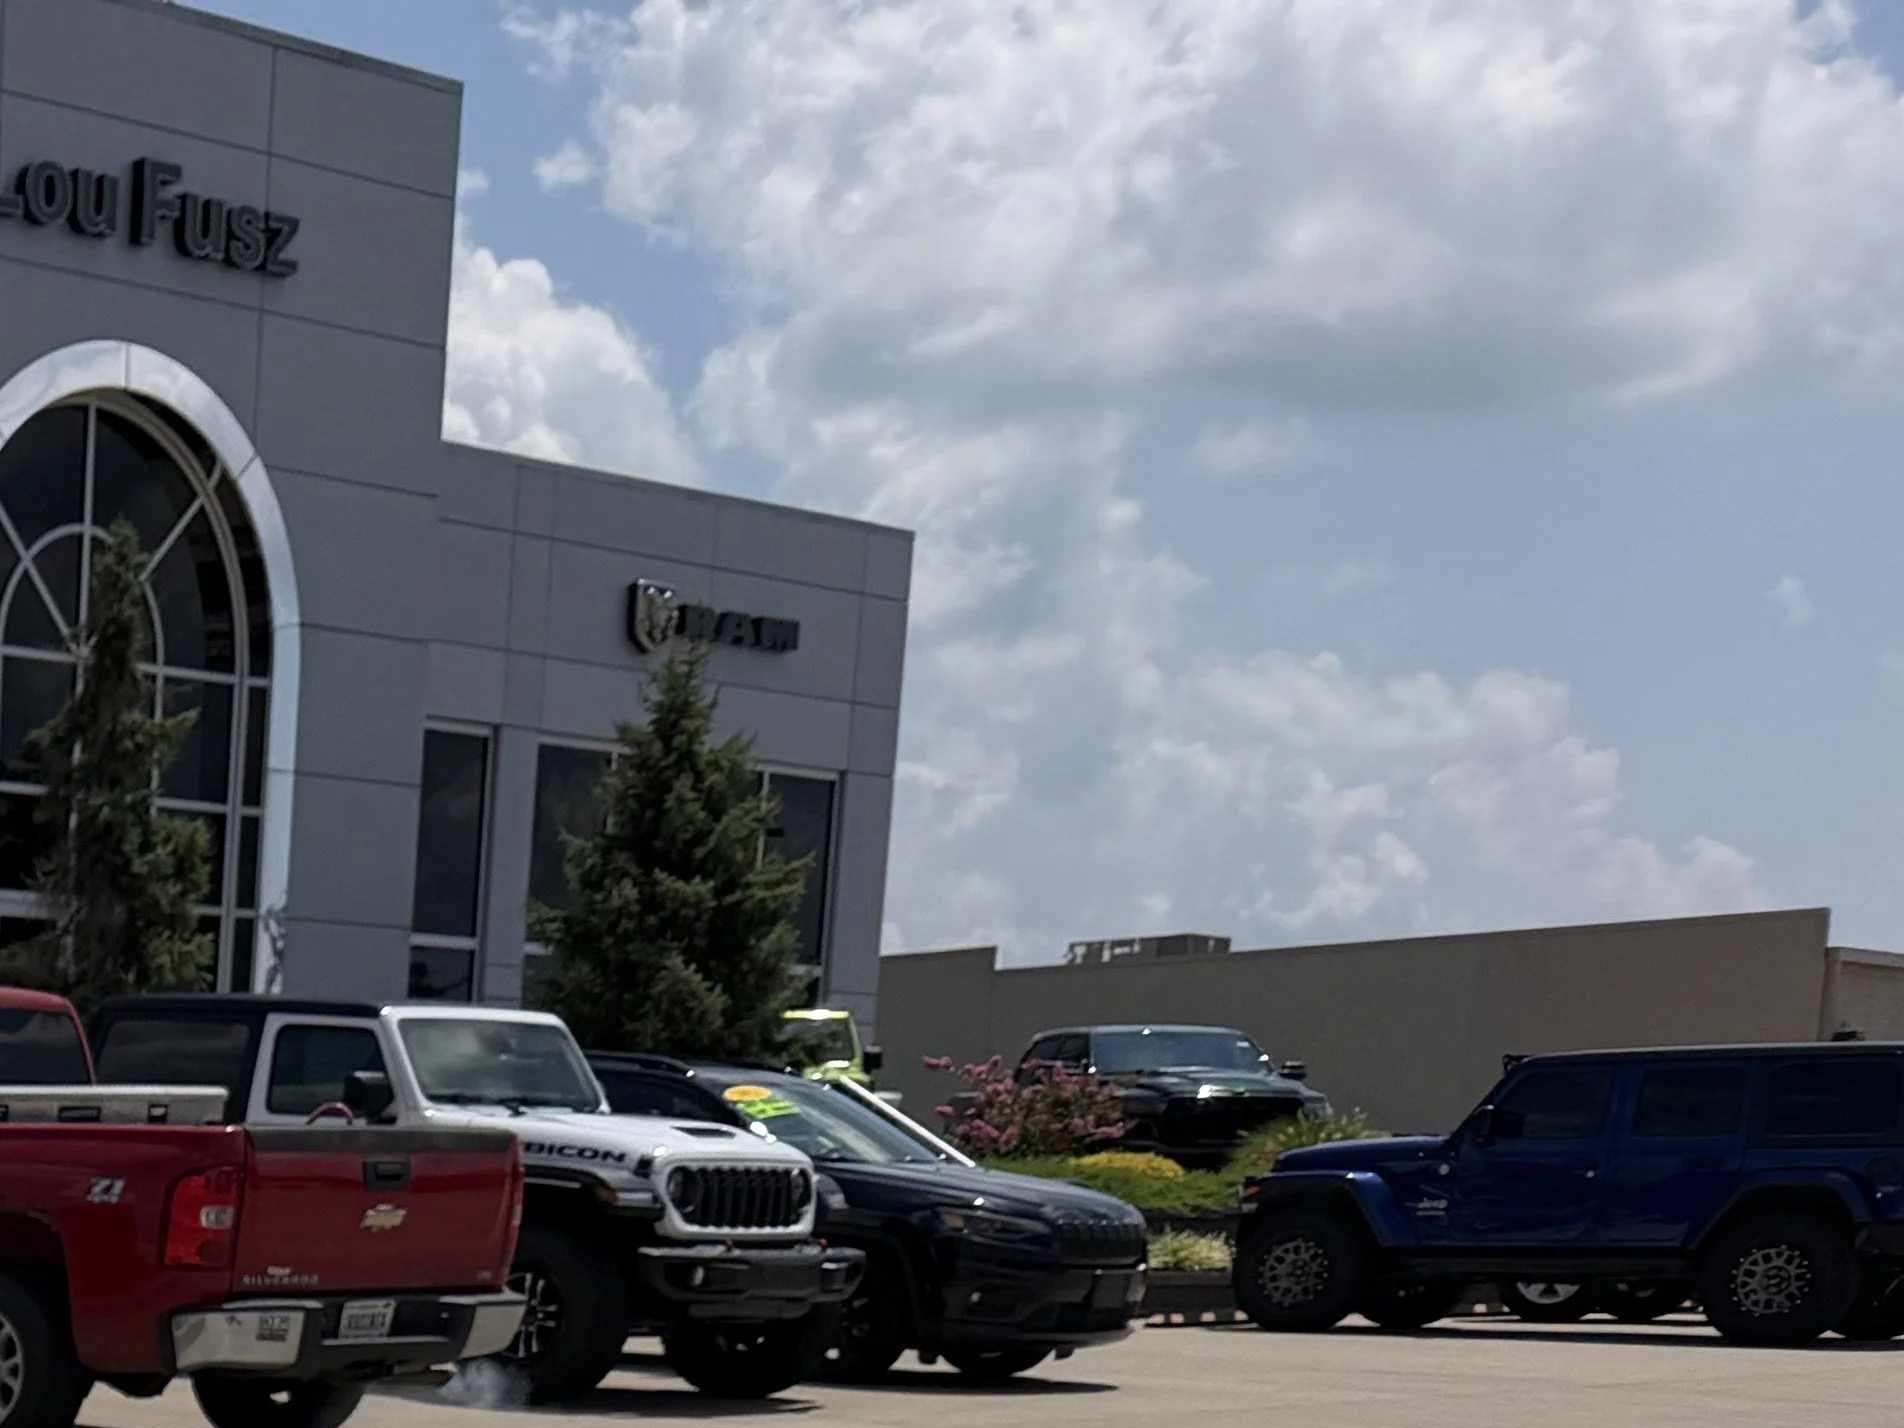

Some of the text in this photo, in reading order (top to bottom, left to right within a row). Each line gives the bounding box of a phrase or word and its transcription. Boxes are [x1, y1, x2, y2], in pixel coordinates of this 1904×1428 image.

[128, 156, 301, 277] Fusz
[674, 604, 800, 652] RAM
[523, 1141, 626, 1163] BICON
